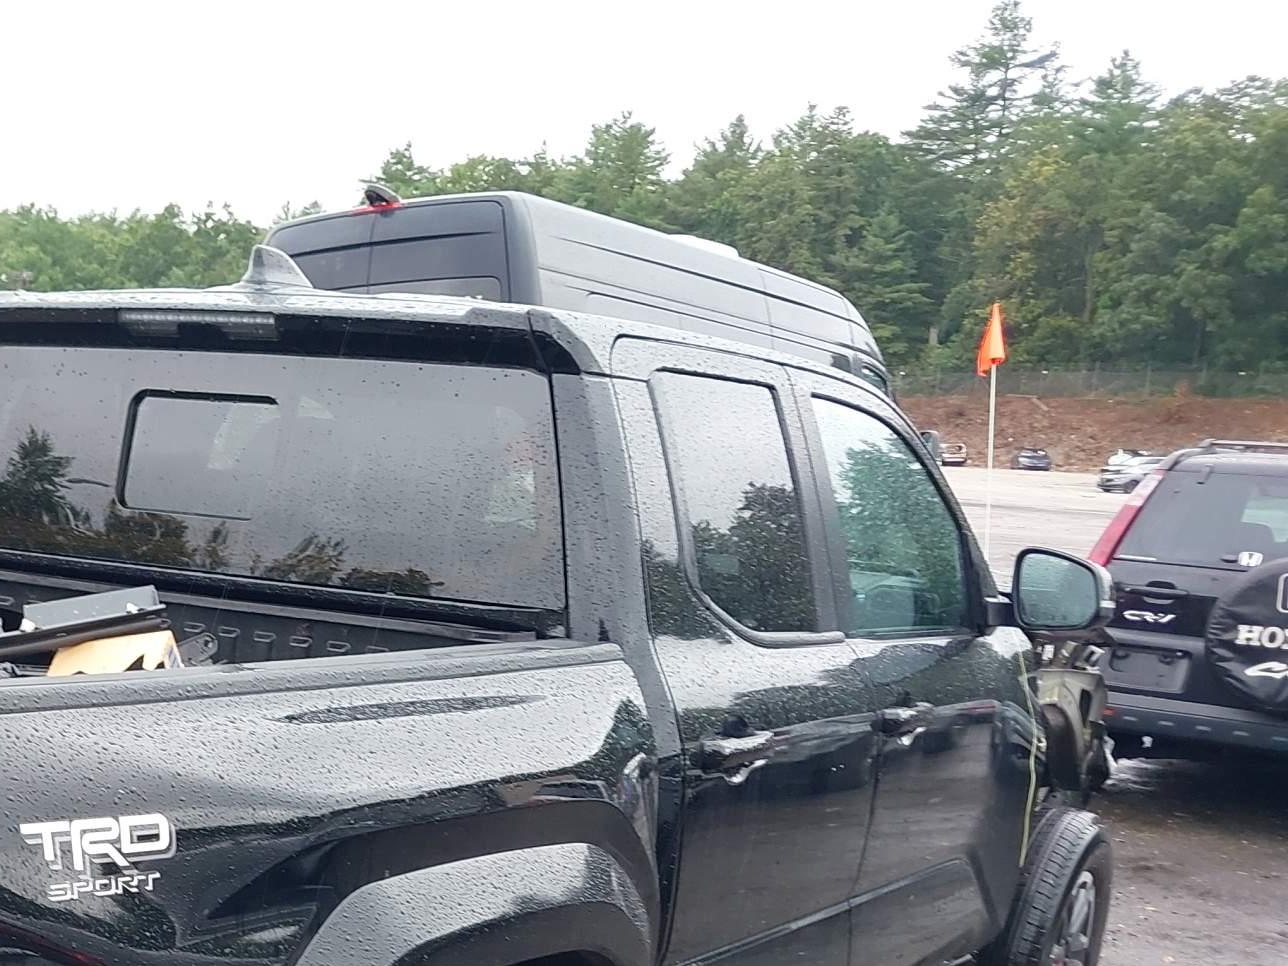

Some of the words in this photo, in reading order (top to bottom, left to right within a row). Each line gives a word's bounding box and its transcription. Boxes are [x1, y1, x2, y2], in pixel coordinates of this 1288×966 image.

[1235, 624, 1288, 650] HO
[19, 813, 177, 876] TRD
[47, 871, 161, 901] SPORT
